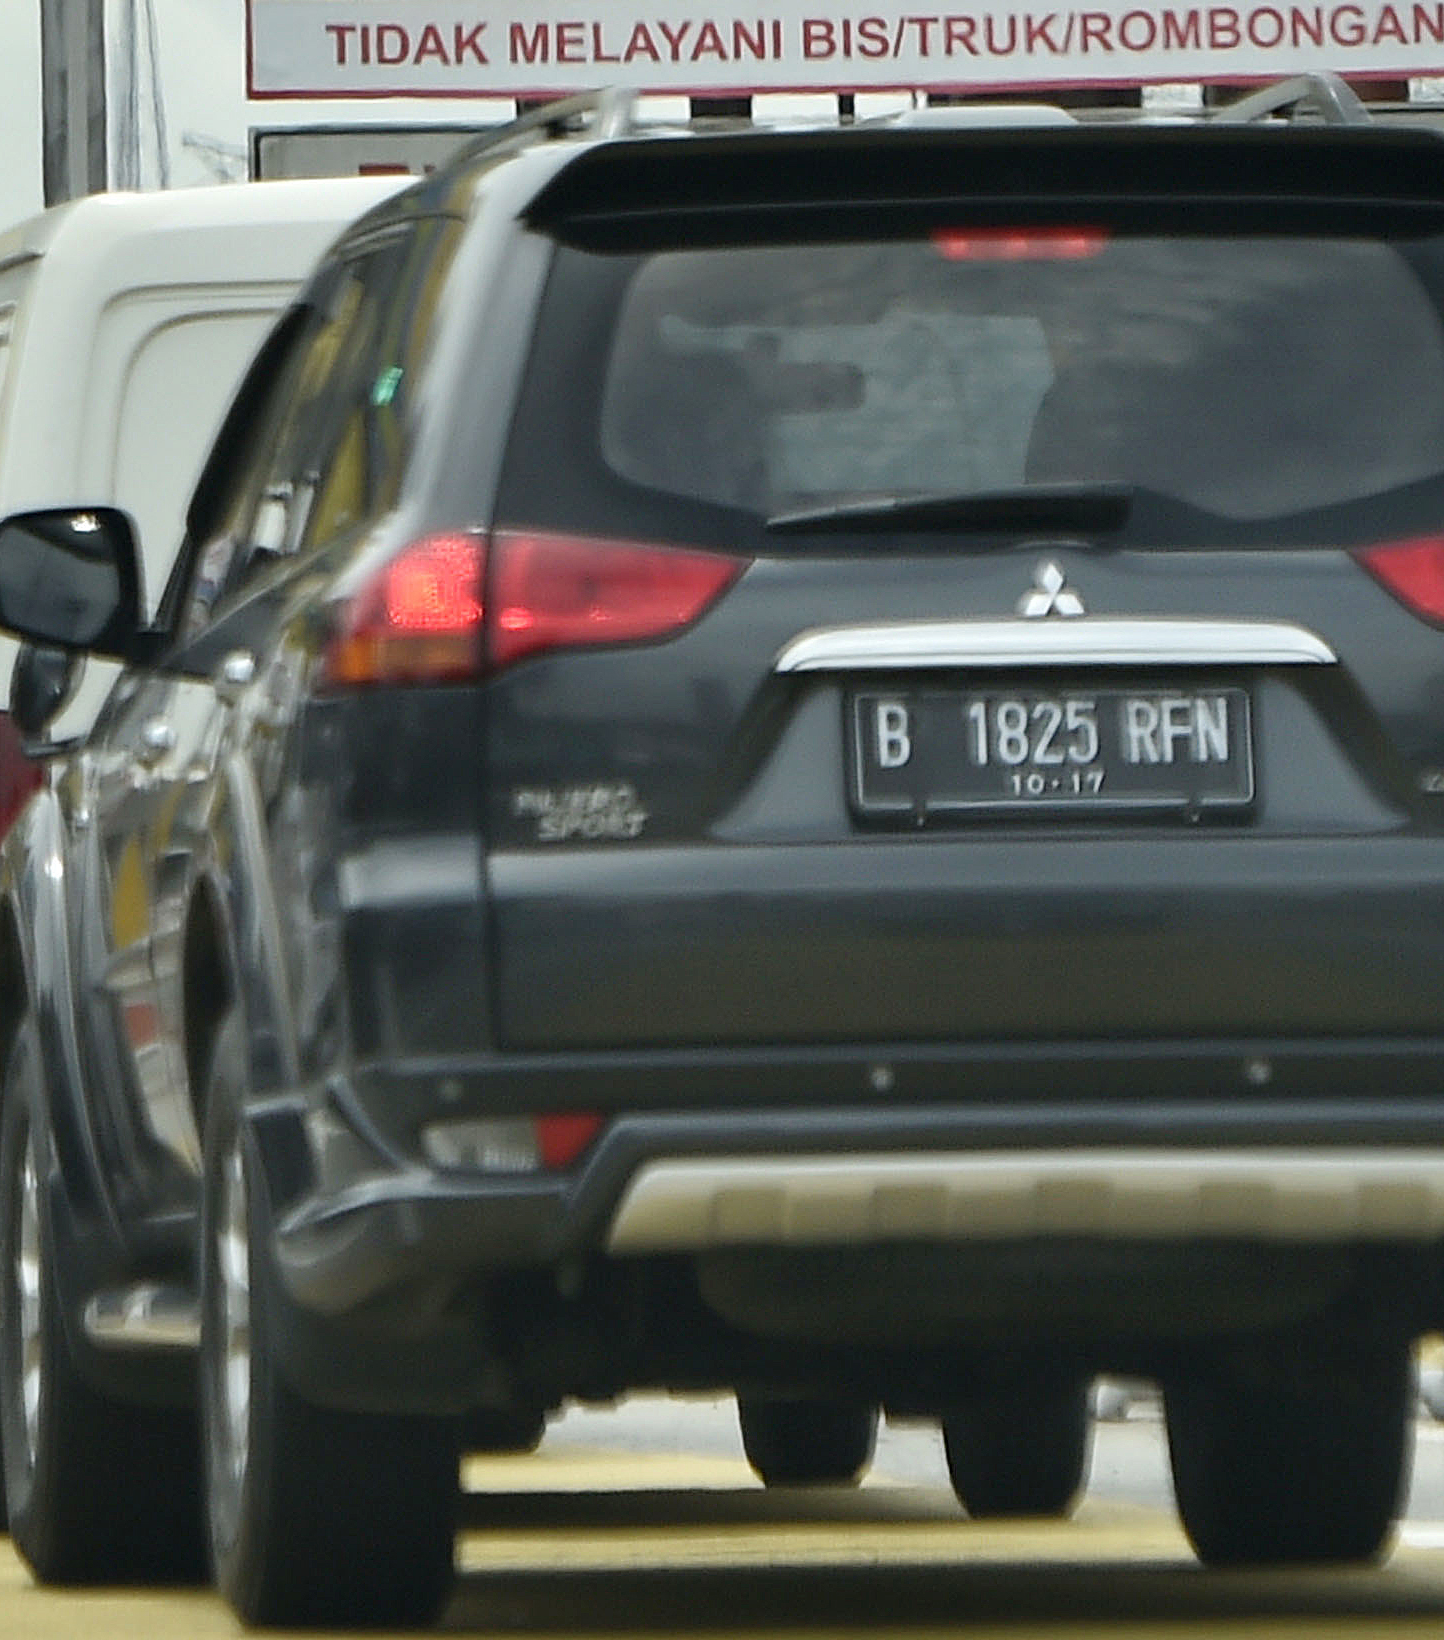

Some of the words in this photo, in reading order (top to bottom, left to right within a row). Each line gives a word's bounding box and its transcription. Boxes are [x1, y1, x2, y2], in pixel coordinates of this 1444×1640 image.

[329, 23, 489, 65] TIDAK
[510, 21, 783, 65] MELAYANI
[877, 698, 912, 768] B
[968, 698, 1100, 765] 1825
[1127, 696, 1230, 762] RFN
